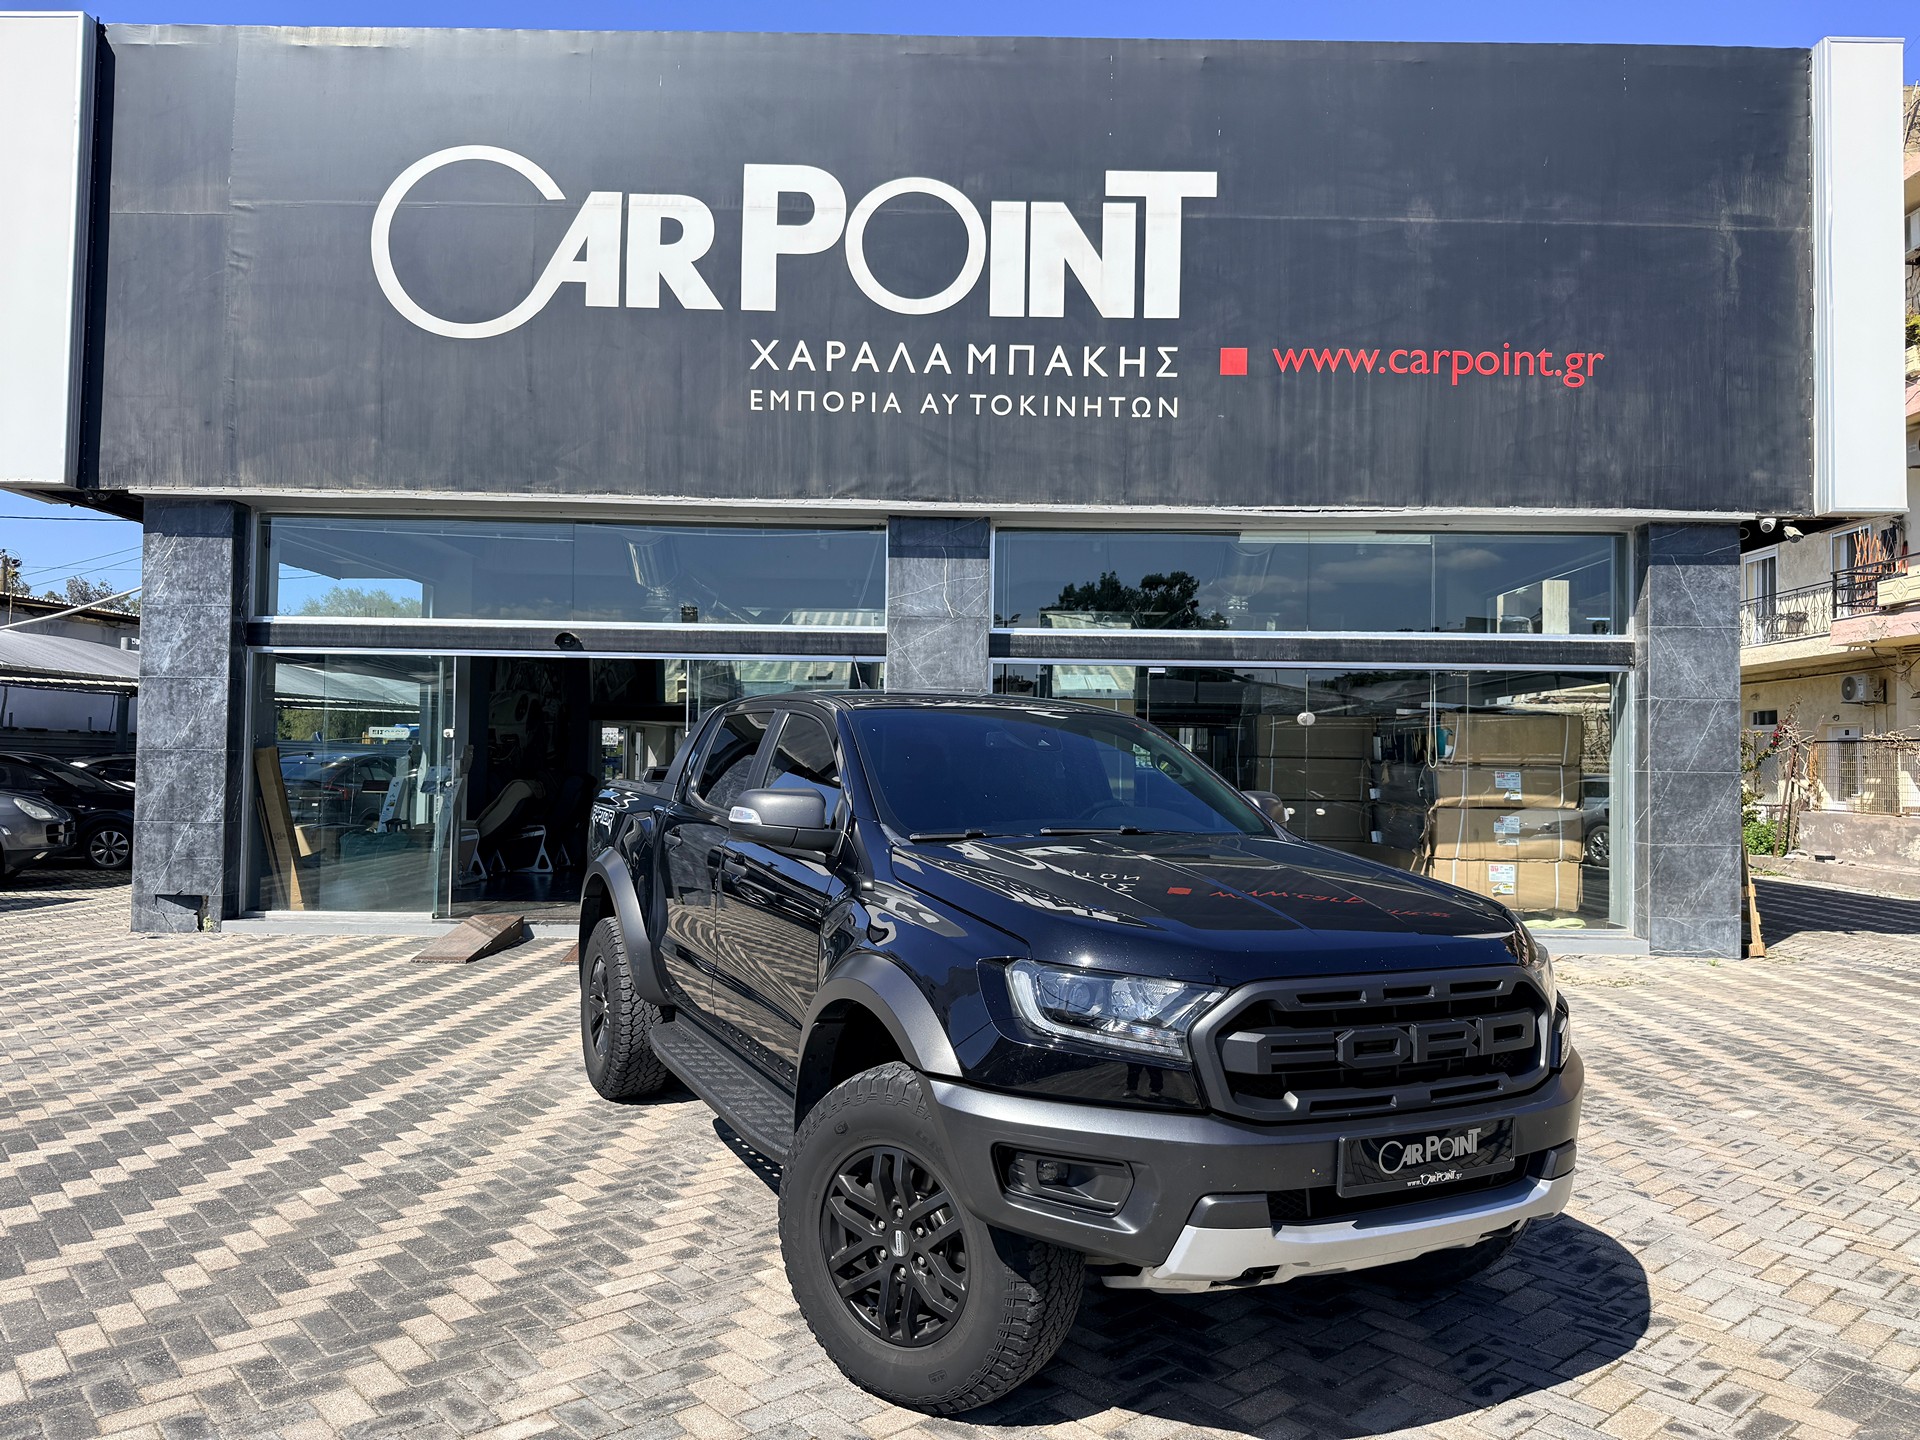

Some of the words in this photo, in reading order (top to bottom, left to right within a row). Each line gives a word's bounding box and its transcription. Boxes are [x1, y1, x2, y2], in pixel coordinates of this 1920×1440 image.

[1272, 342, 1606, 388] www.carpoint.gr
[750, 389, 902, 414] ΕΜΠΟΡΙΑ
[1223, 1010, 1536, 1074] FORD
